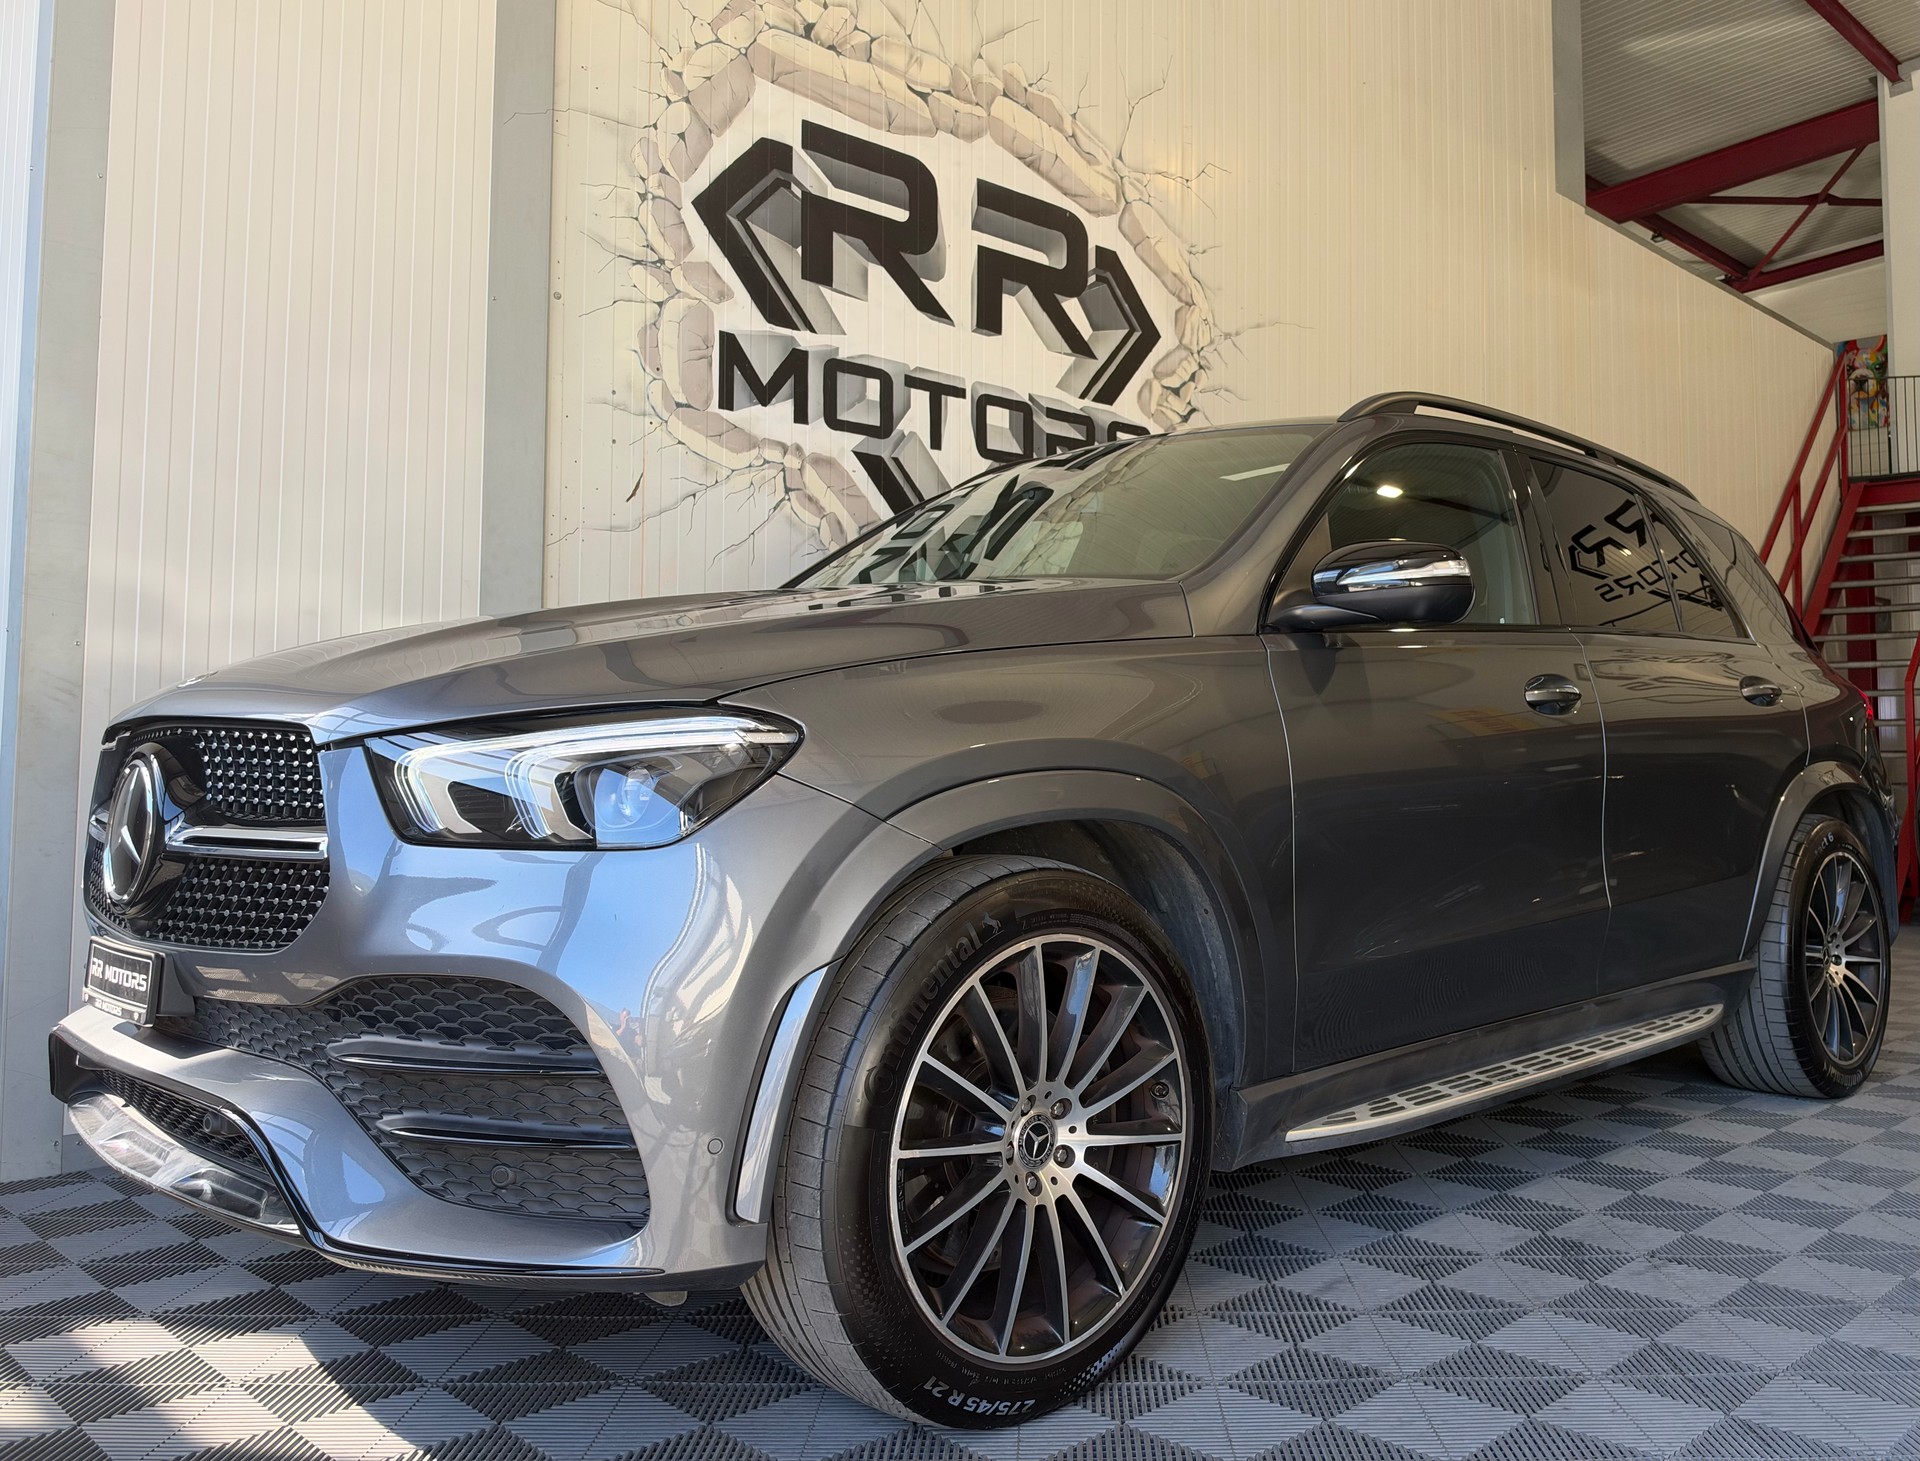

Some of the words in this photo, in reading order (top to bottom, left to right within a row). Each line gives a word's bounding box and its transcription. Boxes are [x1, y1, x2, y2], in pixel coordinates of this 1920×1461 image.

[91, 957, 104, 979] RR
[105, 964, 148, 992] MOTORS
[923, 1375, 950, 1398] 21
[947, 1389, 966, 1407] R
[963, 1397, 1036, 1416] 275/45
